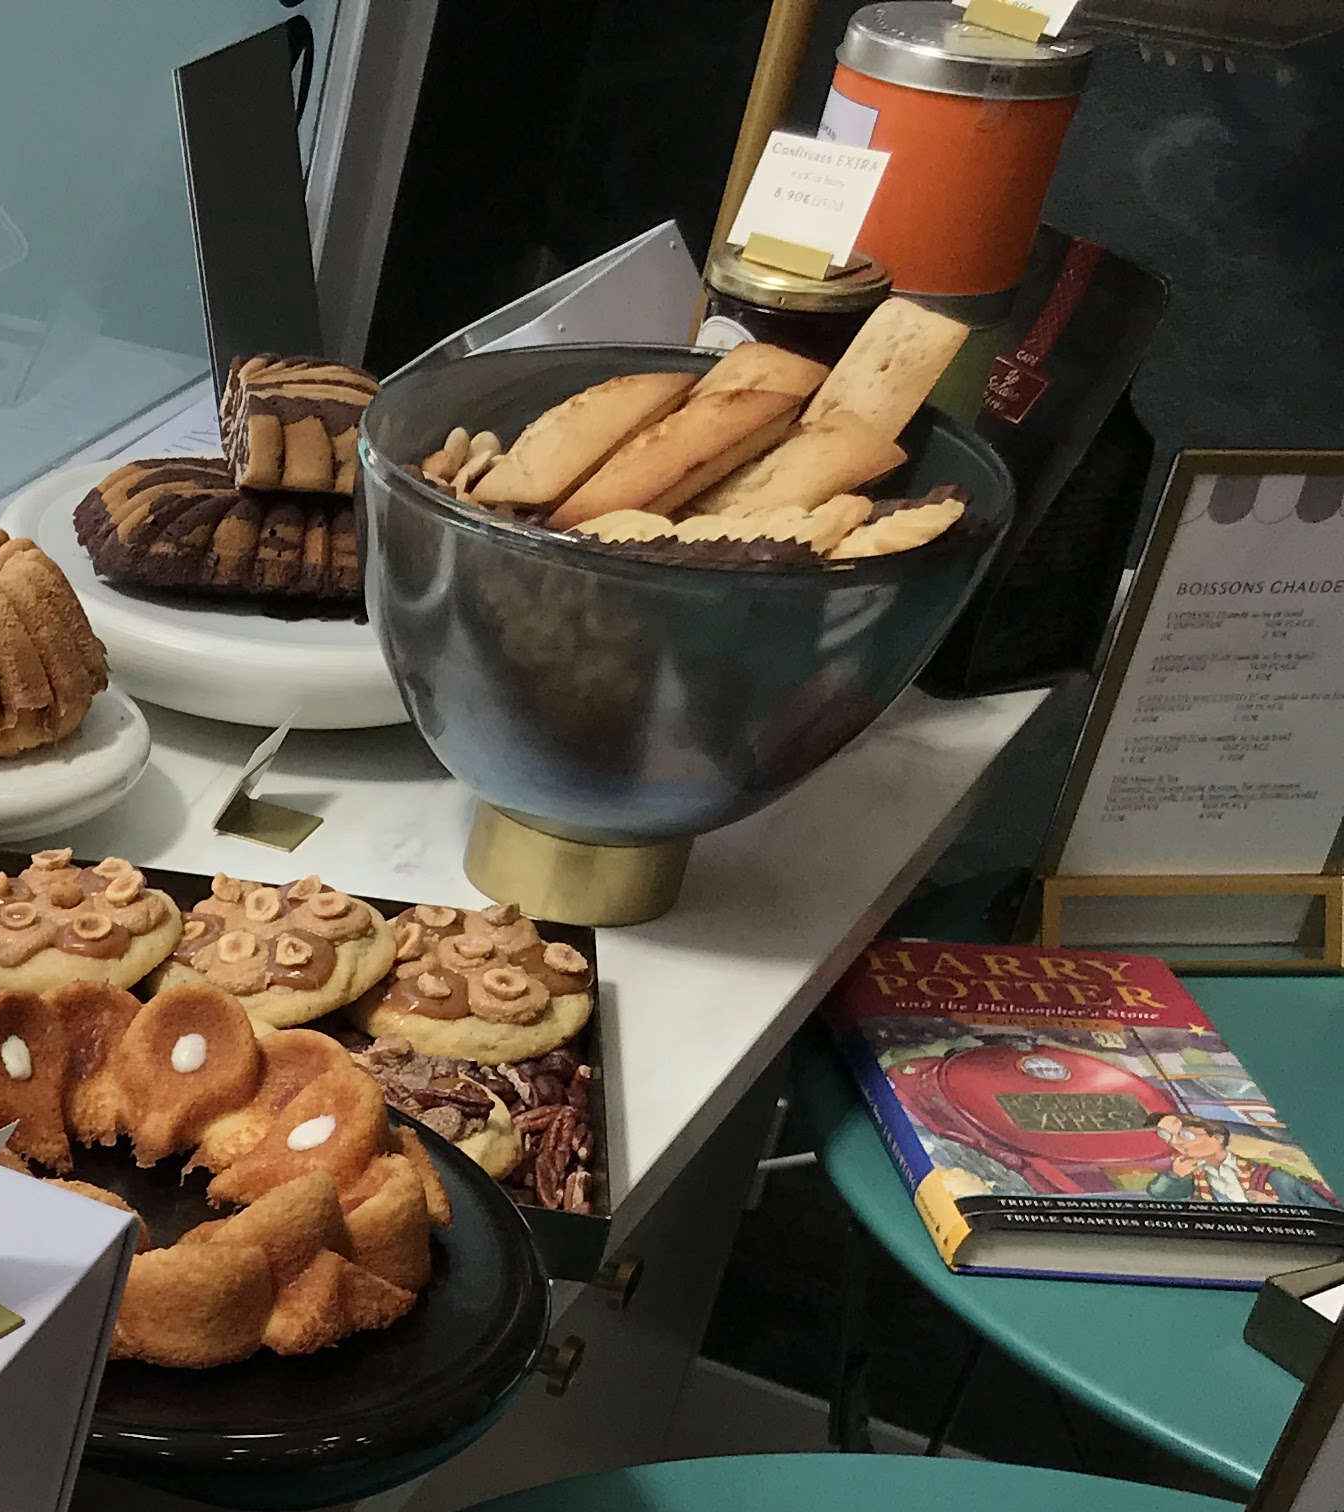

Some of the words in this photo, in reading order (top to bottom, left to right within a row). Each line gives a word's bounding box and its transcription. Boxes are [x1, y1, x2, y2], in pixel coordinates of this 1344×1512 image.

[1176, 581, 1264, 596] BOISSONS
[1269, 580, 1344, 595] CHAUDE
[867, 950, 1134, 983] HARRY
[871, 974, 1169, 1010] POTTER
[1106, 1009, 1161, 1021] Stone
[998, 1199, 1054, 1208] TRIPLE
[1138, 1203, 1184, 1211] GOLD
[1188, 1204, 1244, 1213] AWARD
[1246, 1206, 1311, 1217] WINNER
[1004, 1213, 1060, 1224] TRIPLE
[1063, 1216, 1140, 1228] SMARTIES
[1144, 1220, 1190, 1230] GOLD
[1194, 1223, 1249, 1233] AWARD
[1252, 1225, 1317, 1237] WINNER
